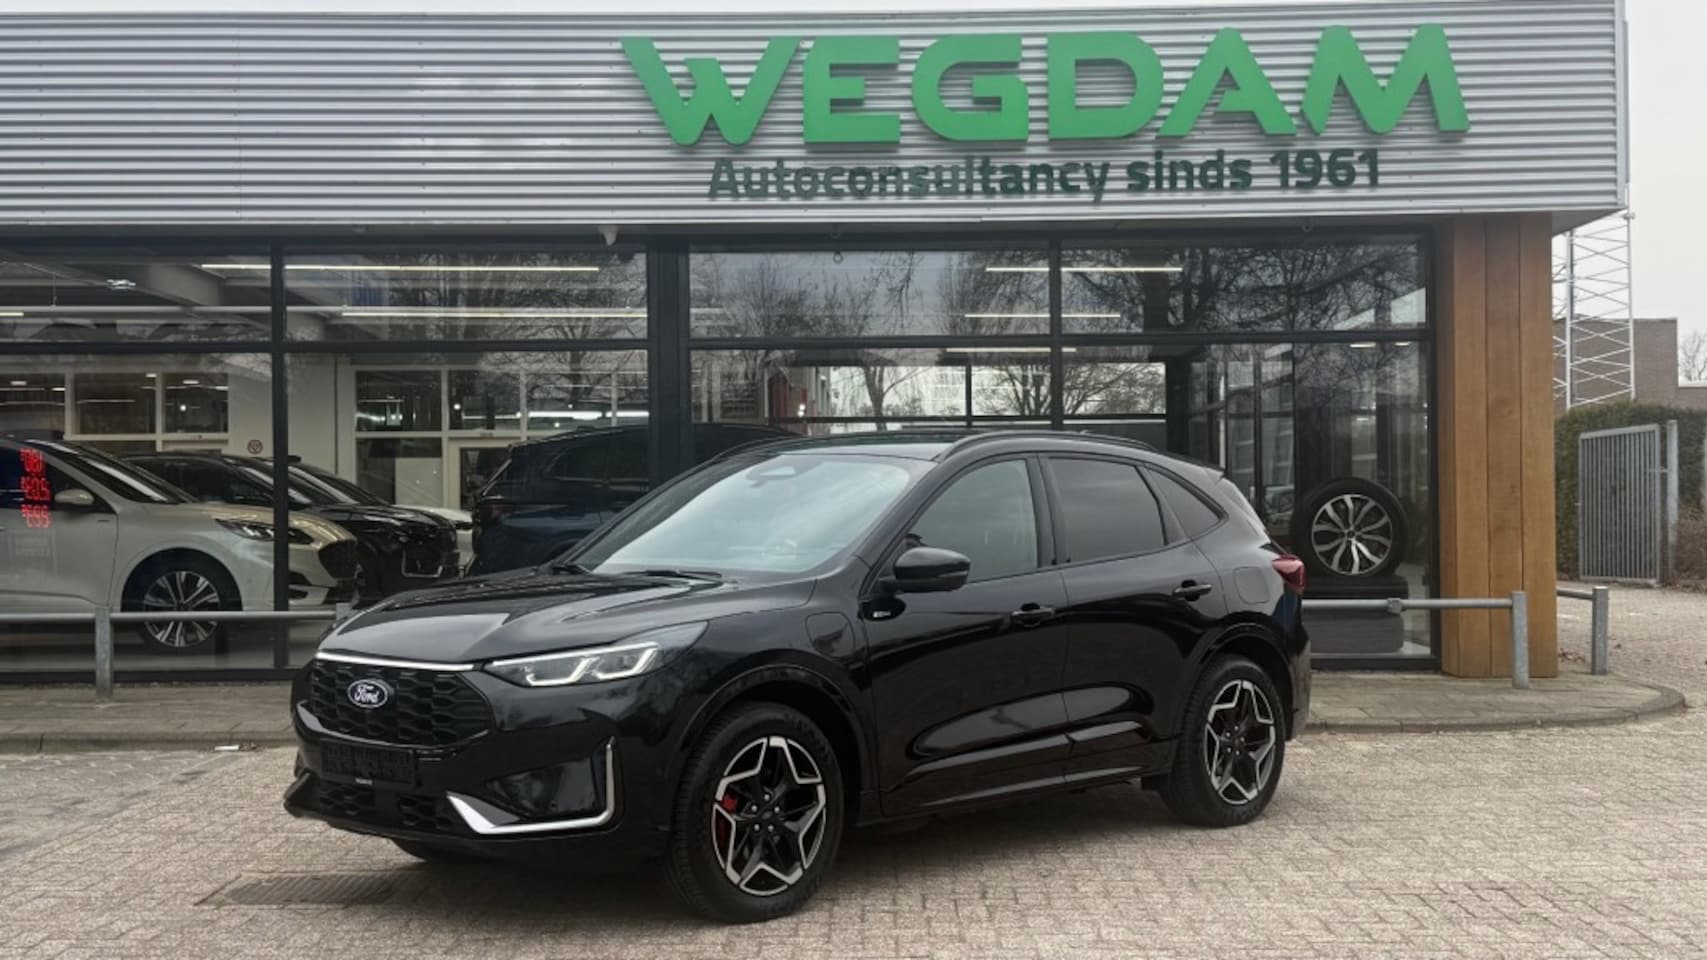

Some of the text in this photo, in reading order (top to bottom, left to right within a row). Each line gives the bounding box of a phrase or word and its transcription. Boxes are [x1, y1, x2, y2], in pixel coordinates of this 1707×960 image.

[620, 24, 1470, 145] WEGDAM
[709, 148, 1379, 206] Autoconsultancy sinds 1961
[354, 684, 379, 703] Ford
